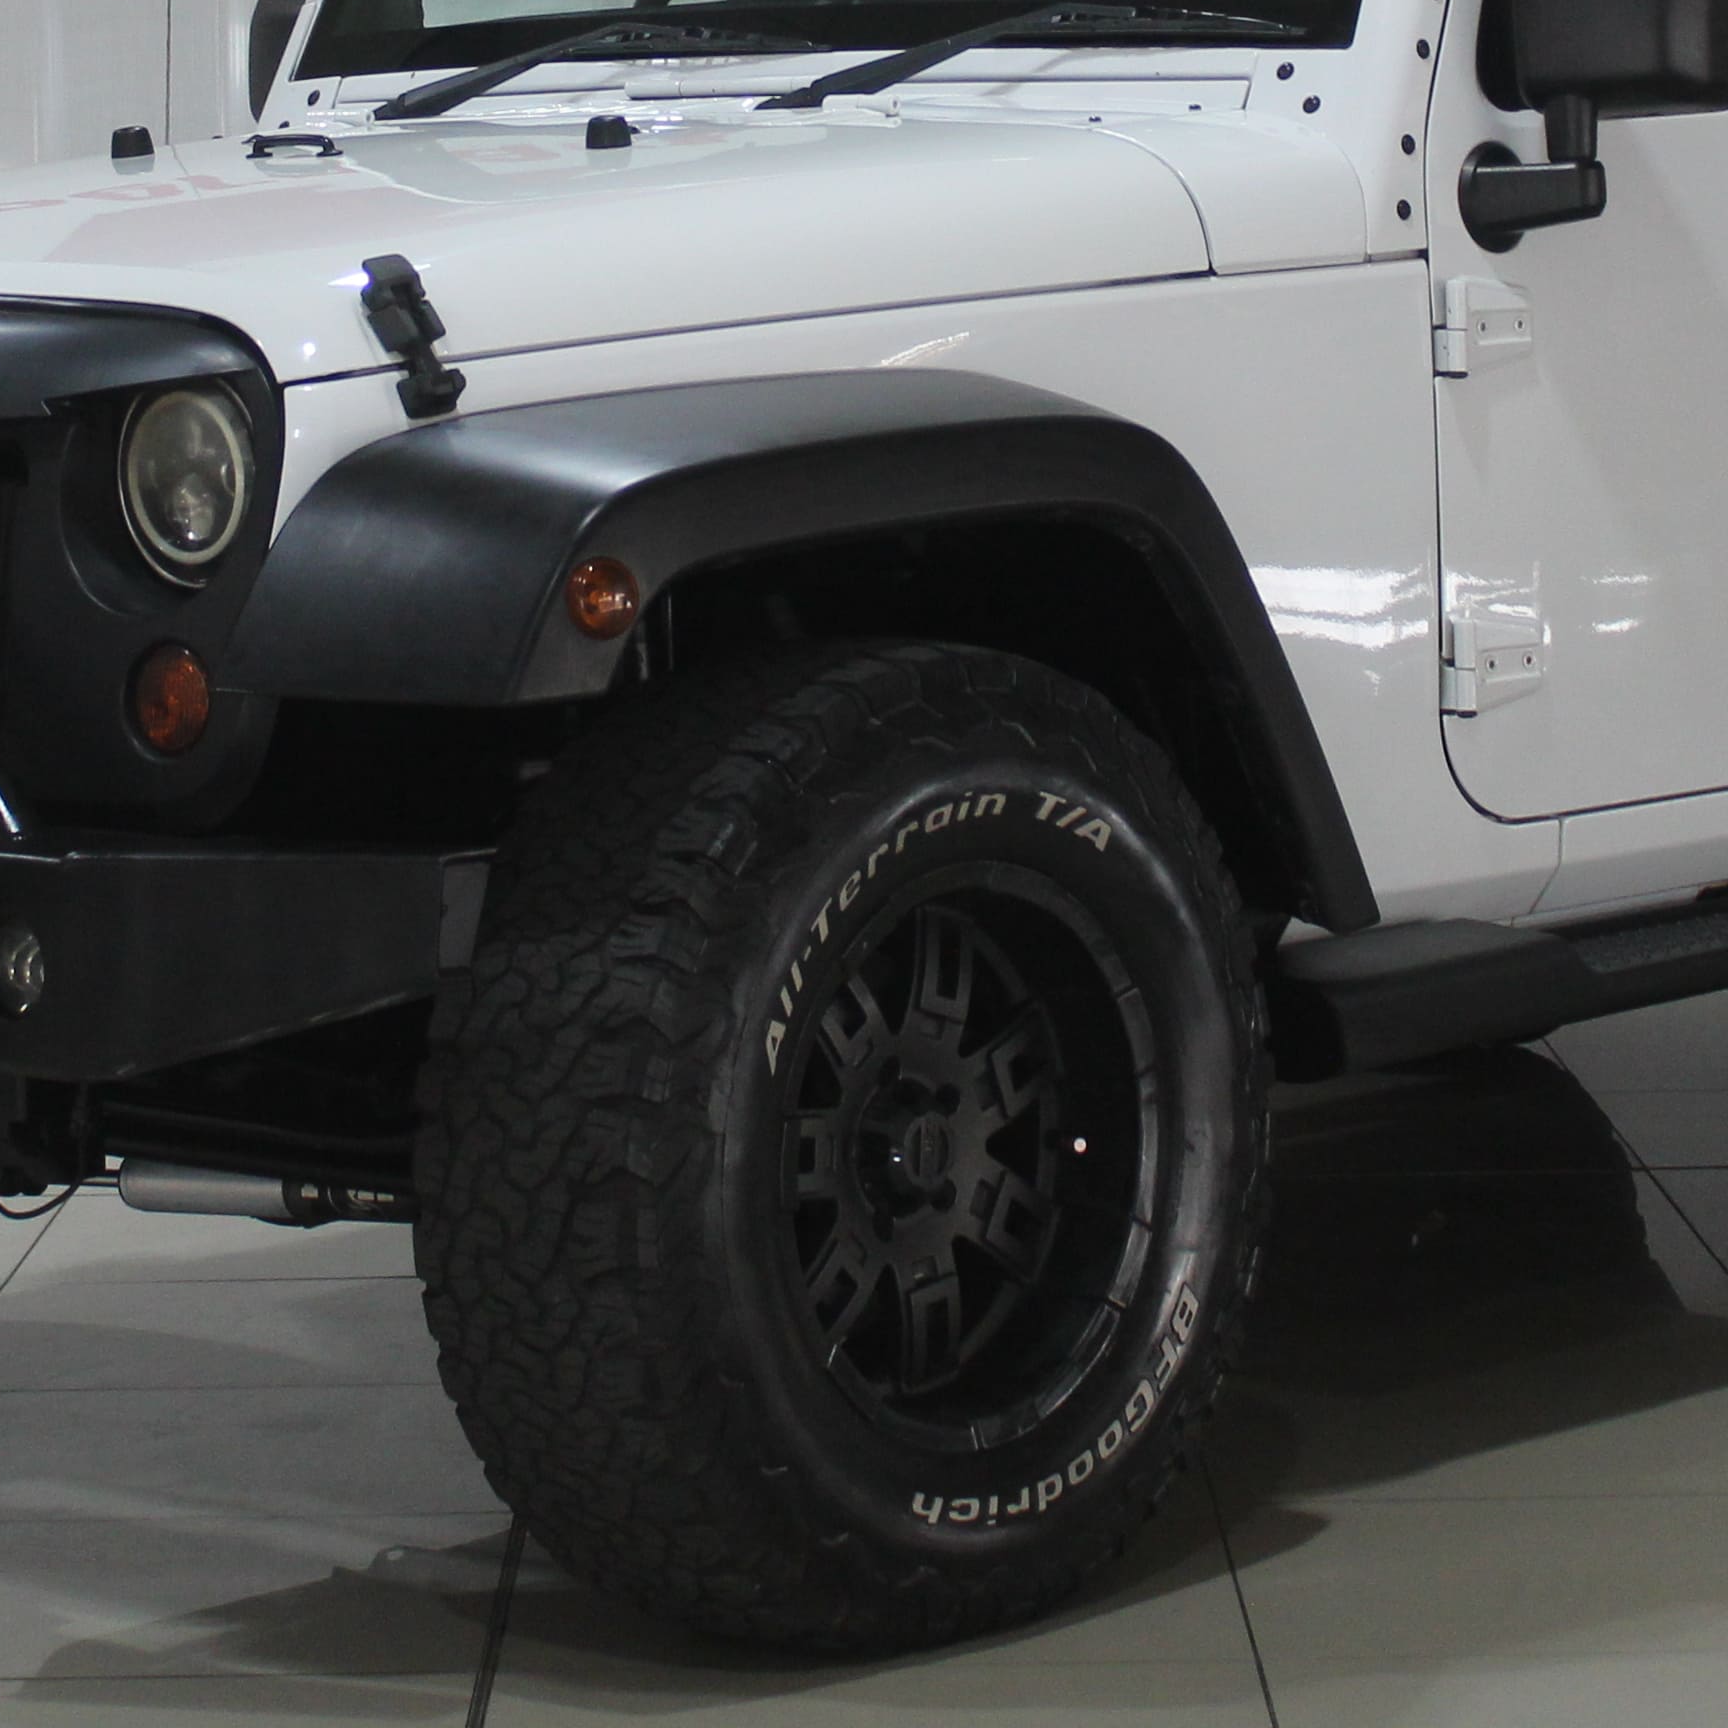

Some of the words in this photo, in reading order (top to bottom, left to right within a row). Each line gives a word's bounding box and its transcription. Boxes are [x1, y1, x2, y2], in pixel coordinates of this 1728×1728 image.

[763, 789, 1007, 1076] All-Terrain
[1033, 789, 1113, 852] T/A
[912, 1281, 1200, 1525] BFGoodrich
